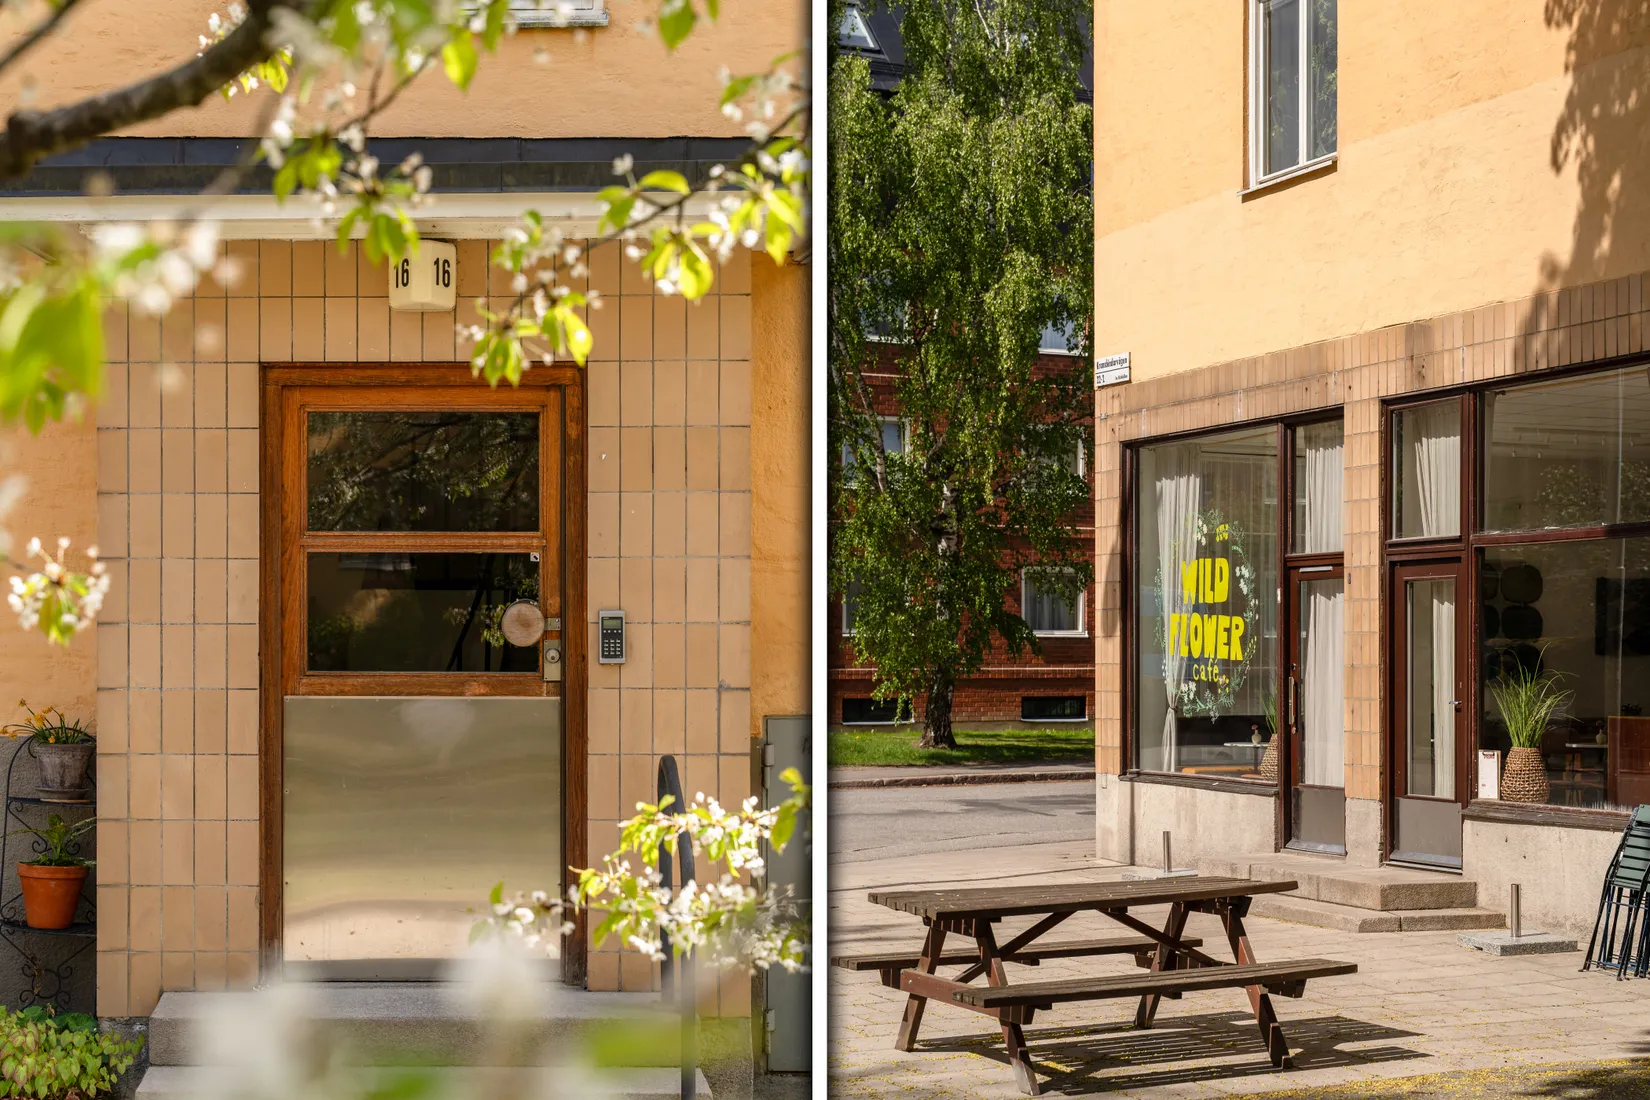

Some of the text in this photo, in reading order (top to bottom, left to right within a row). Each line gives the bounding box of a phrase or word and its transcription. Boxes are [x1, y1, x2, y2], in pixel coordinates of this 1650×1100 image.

[434, 257, 450, 288] 16
[1182, 557, 1229, 605] WILD
[1169, 612, 1245, 661] FLOWER
[1192, 658, 1219, 682] café
